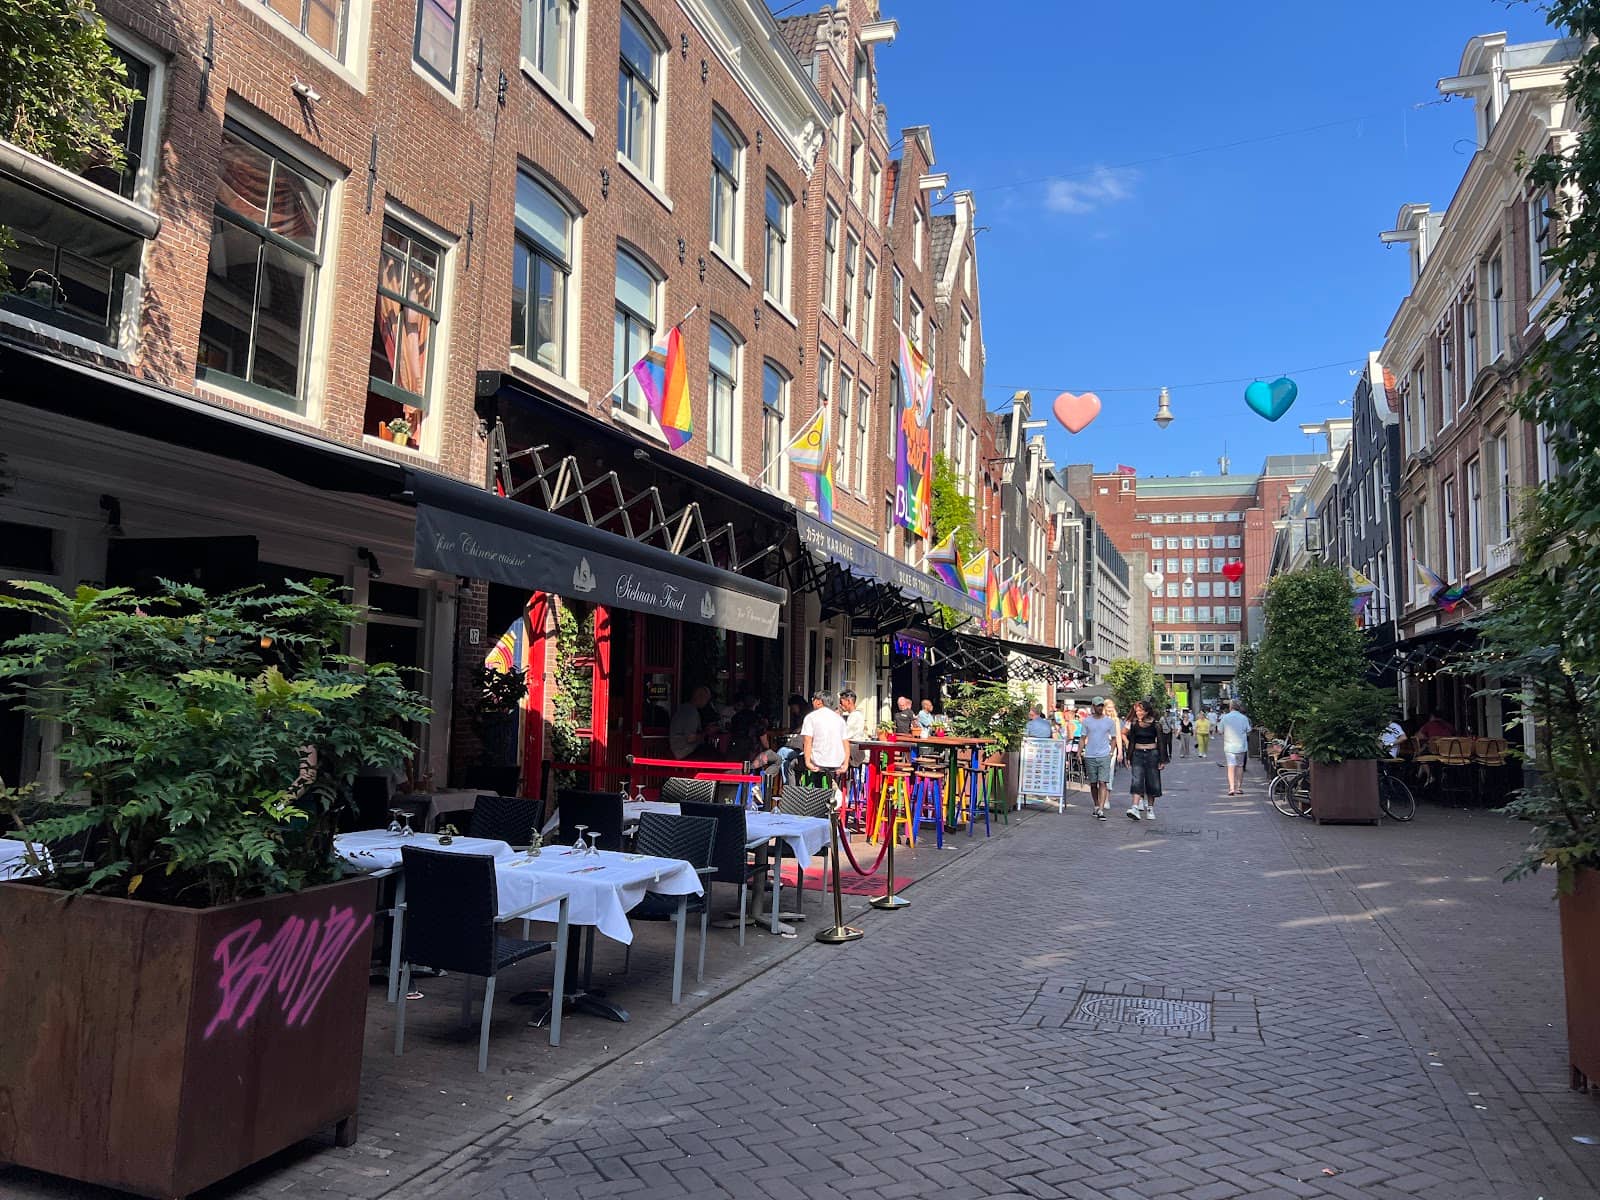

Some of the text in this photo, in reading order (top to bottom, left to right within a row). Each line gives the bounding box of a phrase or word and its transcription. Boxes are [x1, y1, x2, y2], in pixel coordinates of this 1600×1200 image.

[459, 531, 498, 561] Chinese
[826, 535, 854, 561] KARAOKE
[615, 573, 687, 611] Sichuan Food
